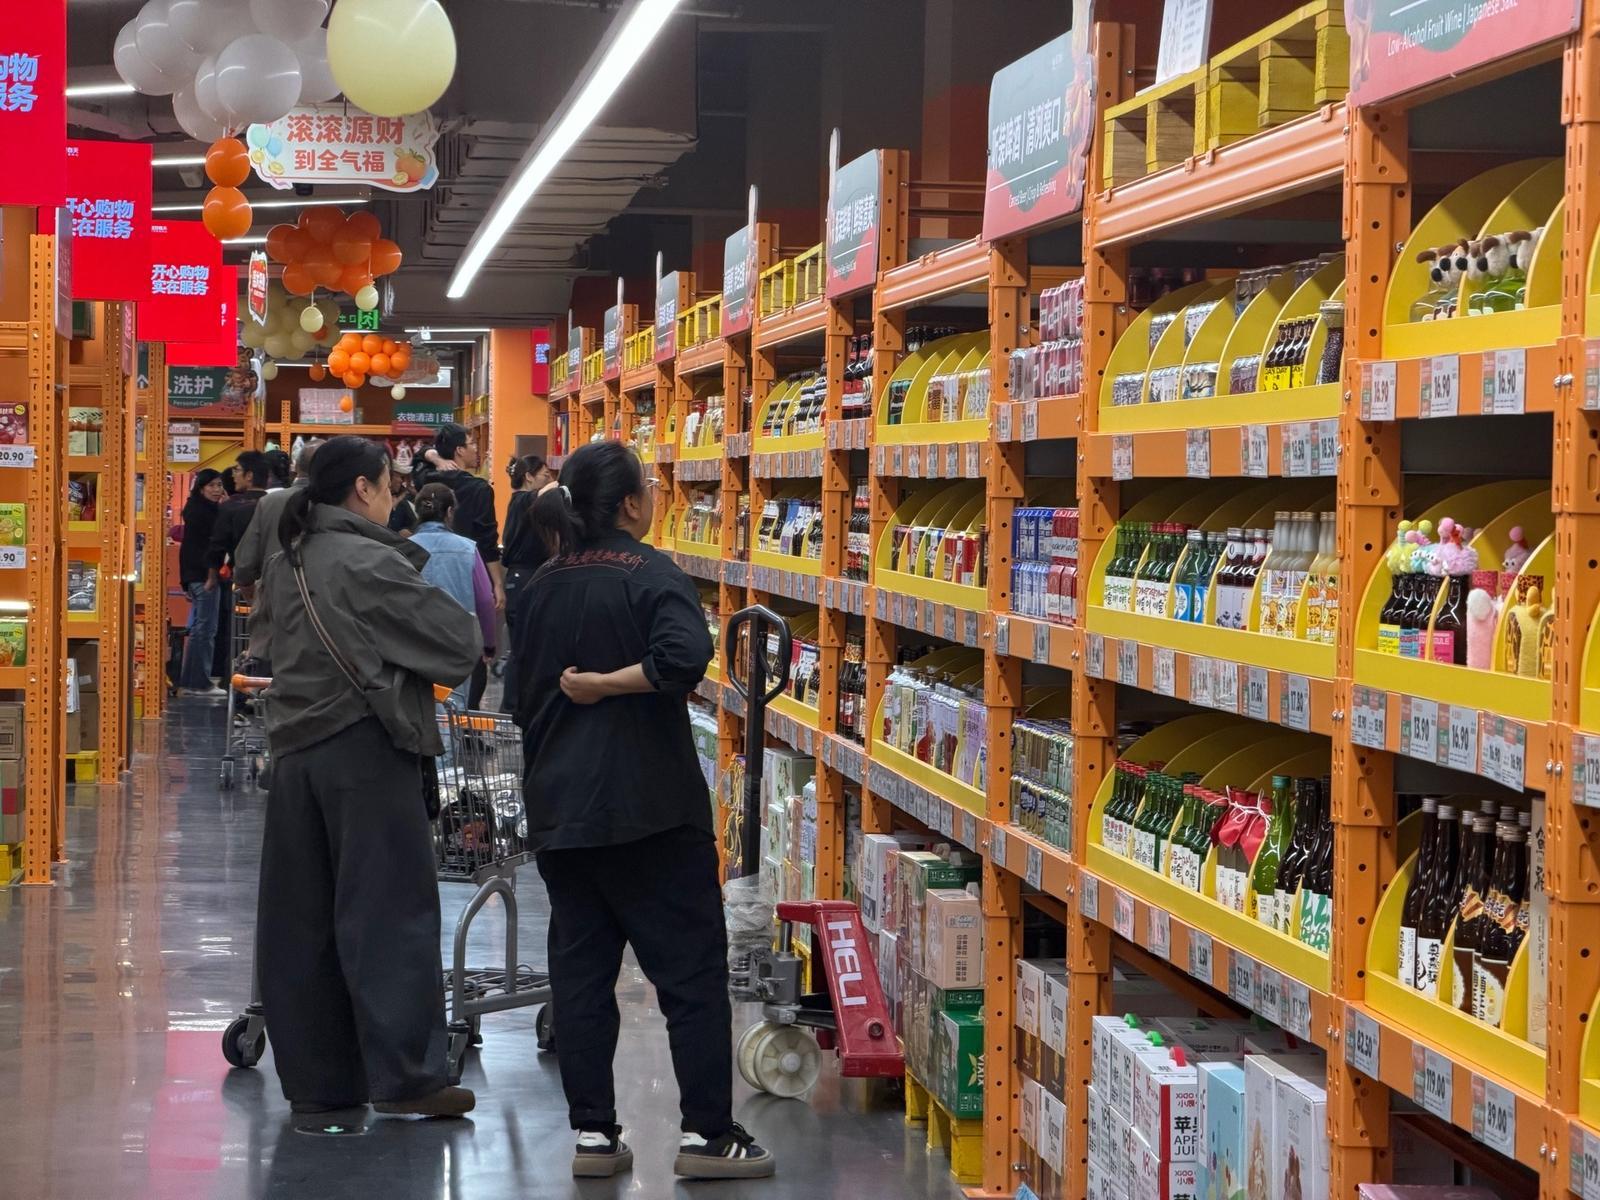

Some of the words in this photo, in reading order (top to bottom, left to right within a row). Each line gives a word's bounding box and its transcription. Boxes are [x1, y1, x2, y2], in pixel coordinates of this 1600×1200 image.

[1387, 20, 1427, 57] Low-Alcohol
[1427, 15, 1444, 41] Fruit
[1445, 11, 1462, 36] Wine
[1465, 1, 1501, 29] Japanese
[72, 217, 135, 239] 在服务
[151, 264, 209, 280] 开心购物
[151, 280, 209, 296] 实在服务
[168, 375, 214, 395] 洗护
[1374, 380, 1389, 403] 16.90
[1434, 375, 1450, 399] 16.90
[1498, 369, 1517, 395] 16.90
[175, 444, 199, 454] 32.90
[1413, 716, 1430, 742] 13.90
[1452, 724, 1469, 752] 16.90
[827, 920, 868, 1007] HELI
[1356, 1029, 1373, 1058] 82.50
[1426, 1068, 1446, 1099] 119.00
[1487, 1101, 1508, 1134] 89.00
